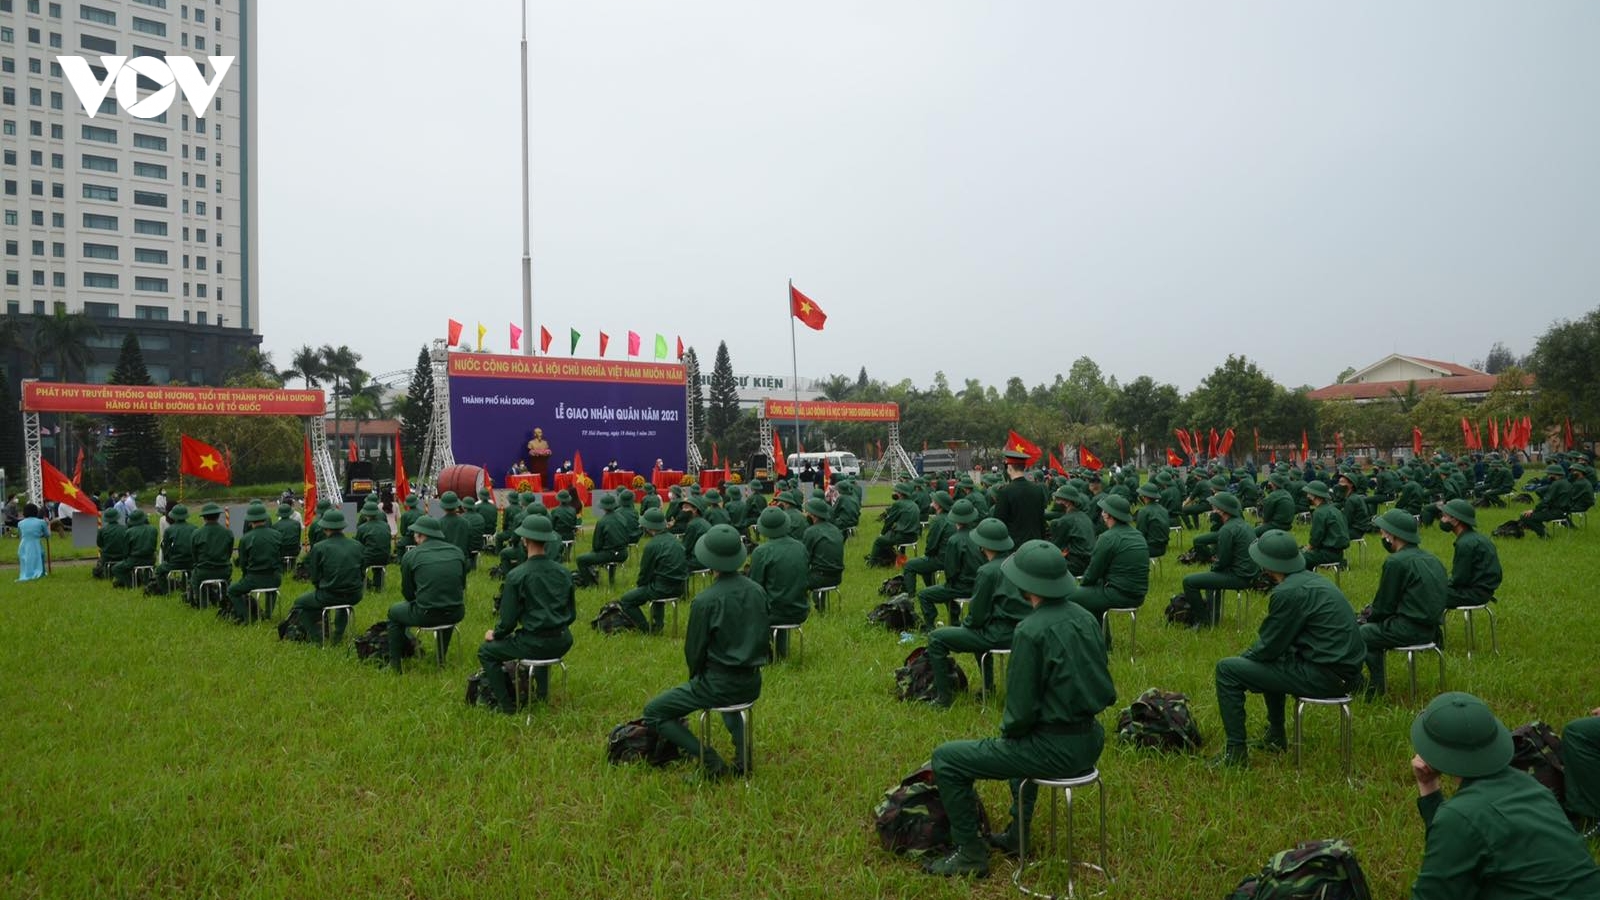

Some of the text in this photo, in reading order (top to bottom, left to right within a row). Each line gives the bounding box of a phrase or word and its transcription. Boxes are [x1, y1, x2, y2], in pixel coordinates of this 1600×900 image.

[454, 357, 481, 371] NƯỚC
[483, 359, 509, 374] CỘNG
[511, 360, 531, 373] HÒA
[532, 360, 545, 374] XÃ
[546, 361, 561, 377] HỘI
[562, 362, 579, 375] CHỦ
[581, 363, 606, 377] NGHĨA
[607, 365, 622, 380] VIỆT
[624, 367, 641, 378] NAM
[643, 366, 665, 379] MUÔN
[666, 368, 683, 380] NĂM
[753, 375, 784, 391] KIỆN
[36, 386, 60, 397] PHÁT
[61, 388, 79, 398] HUY
[82, 386, 113, 398] TRUYỀN
[115, 387, 144, 399] THỐNG
[146, 388, 163, 399] QUÊ
[164, 389, 197, 401] HƯƠNG,
[199, 389, 216, 400] TUỔI
[232, 391, 257, 401] THÀNH
[259, 391, 274, 401] PHỐ
[276, 391, 289, 401] HẢI
[290, 392, 316, 402] DƯƠNG
[462, 394, 535, 406] THÀNH PHỐ HẢI DƯƠNG
[133, 400, 148, 410] HÁI
[150, 400, 164, 410] LÊN
[165, 401, 195, 411] ĐƯỜNG
[197, 401, 214, 411] BẢO
[216, 402, 225, 412] VỆ
[227, 401, 237, 411] TỔ
[238, 401, 261, 412] QUỐC
[555, 402, 679, 423] LỄ GIAO NHẬN QUÂN NĂM 2021
